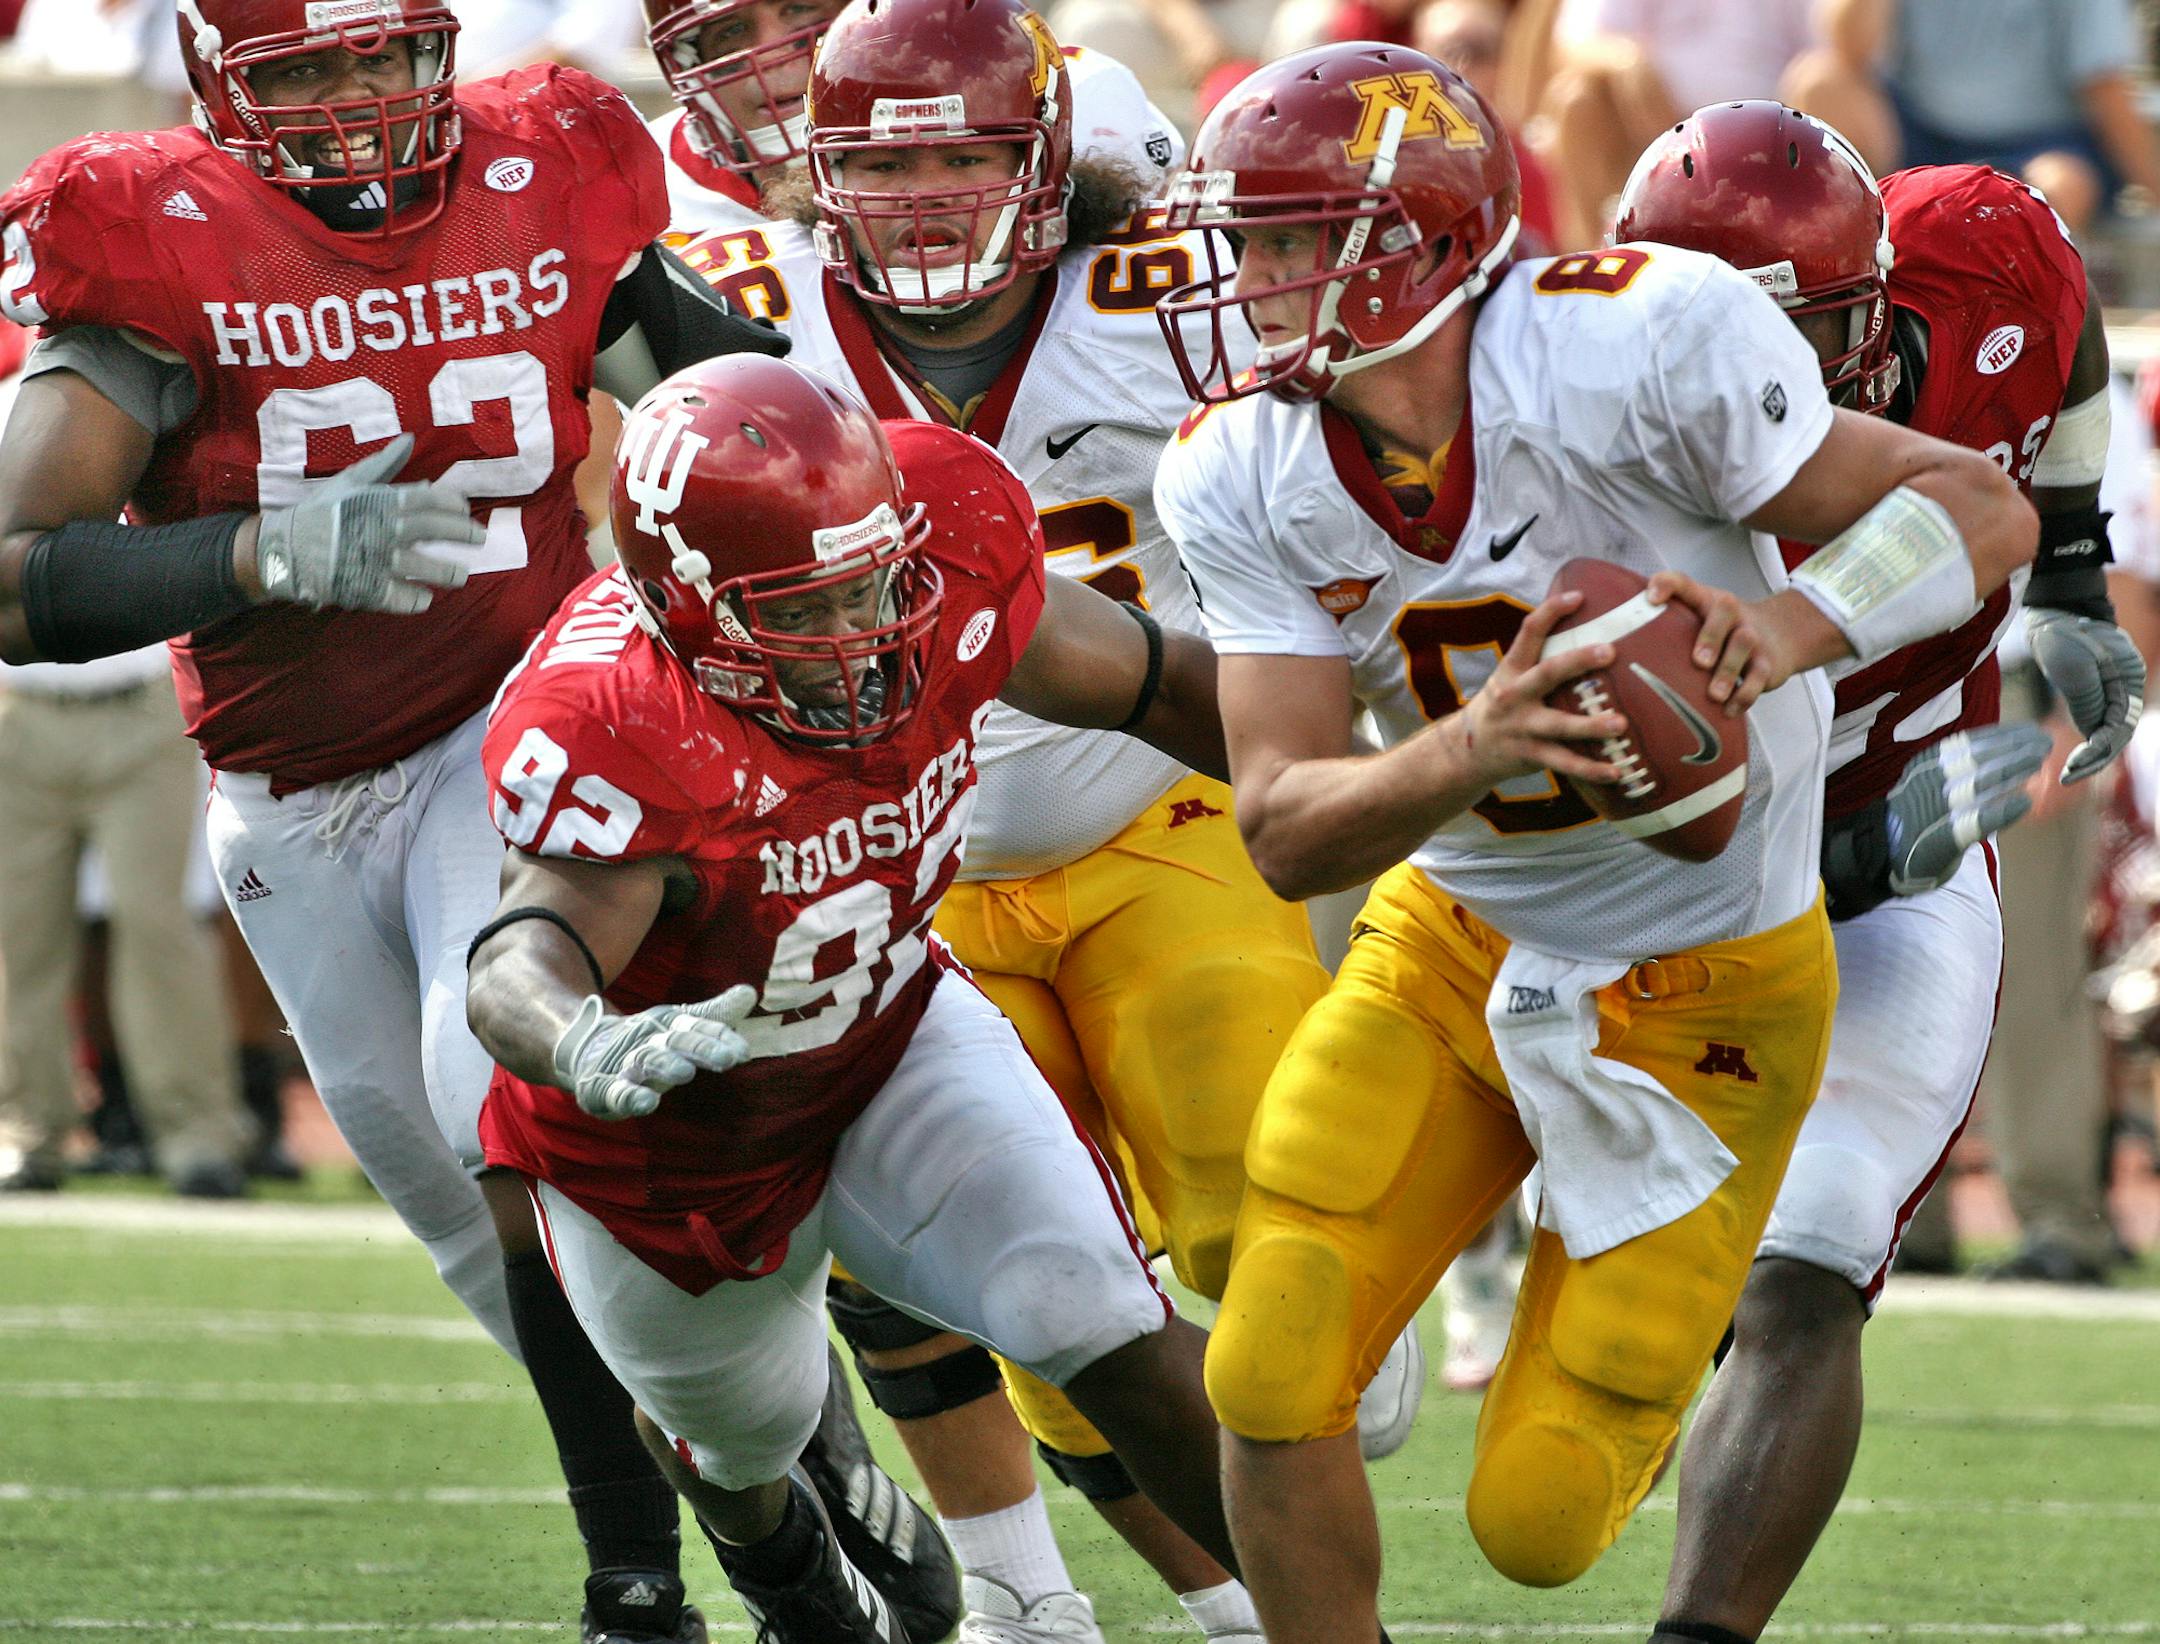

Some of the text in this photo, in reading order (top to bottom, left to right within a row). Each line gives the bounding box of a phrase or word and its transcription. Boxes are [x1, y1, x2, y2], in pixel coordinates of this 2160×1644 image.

[328, 0, 377, 17] HOOSIERS
[895, 104, 942, 118] GOPHERS
[1344, 70, 1487, 165] M
[496, 166, 526, 188] HEP
[162, 206, 209, 221] adidas
[1532, 248, 1655, 298] 8
[203, 248, 568, 367] HOOSIERS
[1987, 336, 2017, 370] HEP
[256, 349, 555, 576] 62
[966, 621, 988, 656] HEP
[494, 727, 643, 866] 92
[754, 788, 787, 817] adidas
[1167, 798, 1224, 830] M
[1694, 1042, 1758, 1083] M
